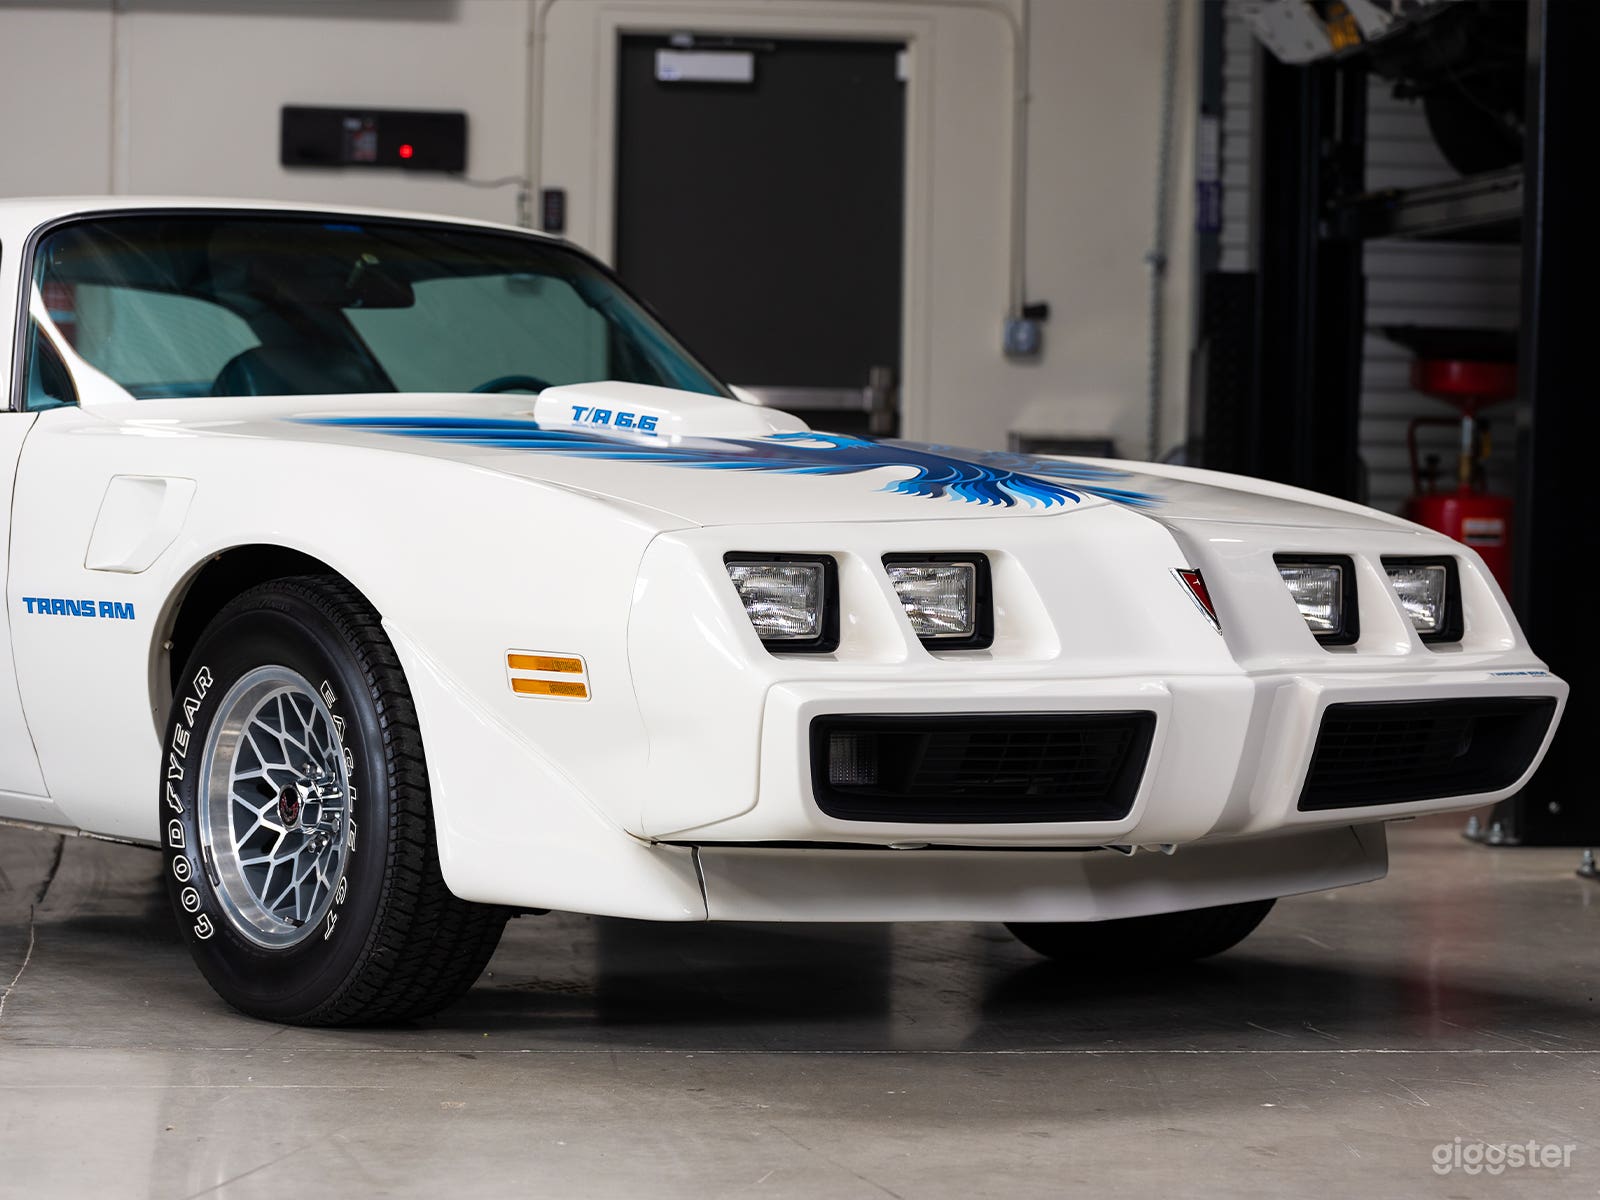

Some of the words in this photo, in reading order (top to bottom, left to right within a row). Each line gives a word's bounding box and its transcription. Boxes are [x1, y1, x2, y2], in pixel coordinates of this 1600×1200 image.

[572, 405, 612, 424] T/A
[614, 411, 659, 431] 6.6
[22, 597, 97, 617] TRANS
[99, 601, 135, 620] AM
[166, 665, 214, 940] GOODYEAR
[320, 680, 357, 852] EAGLE
